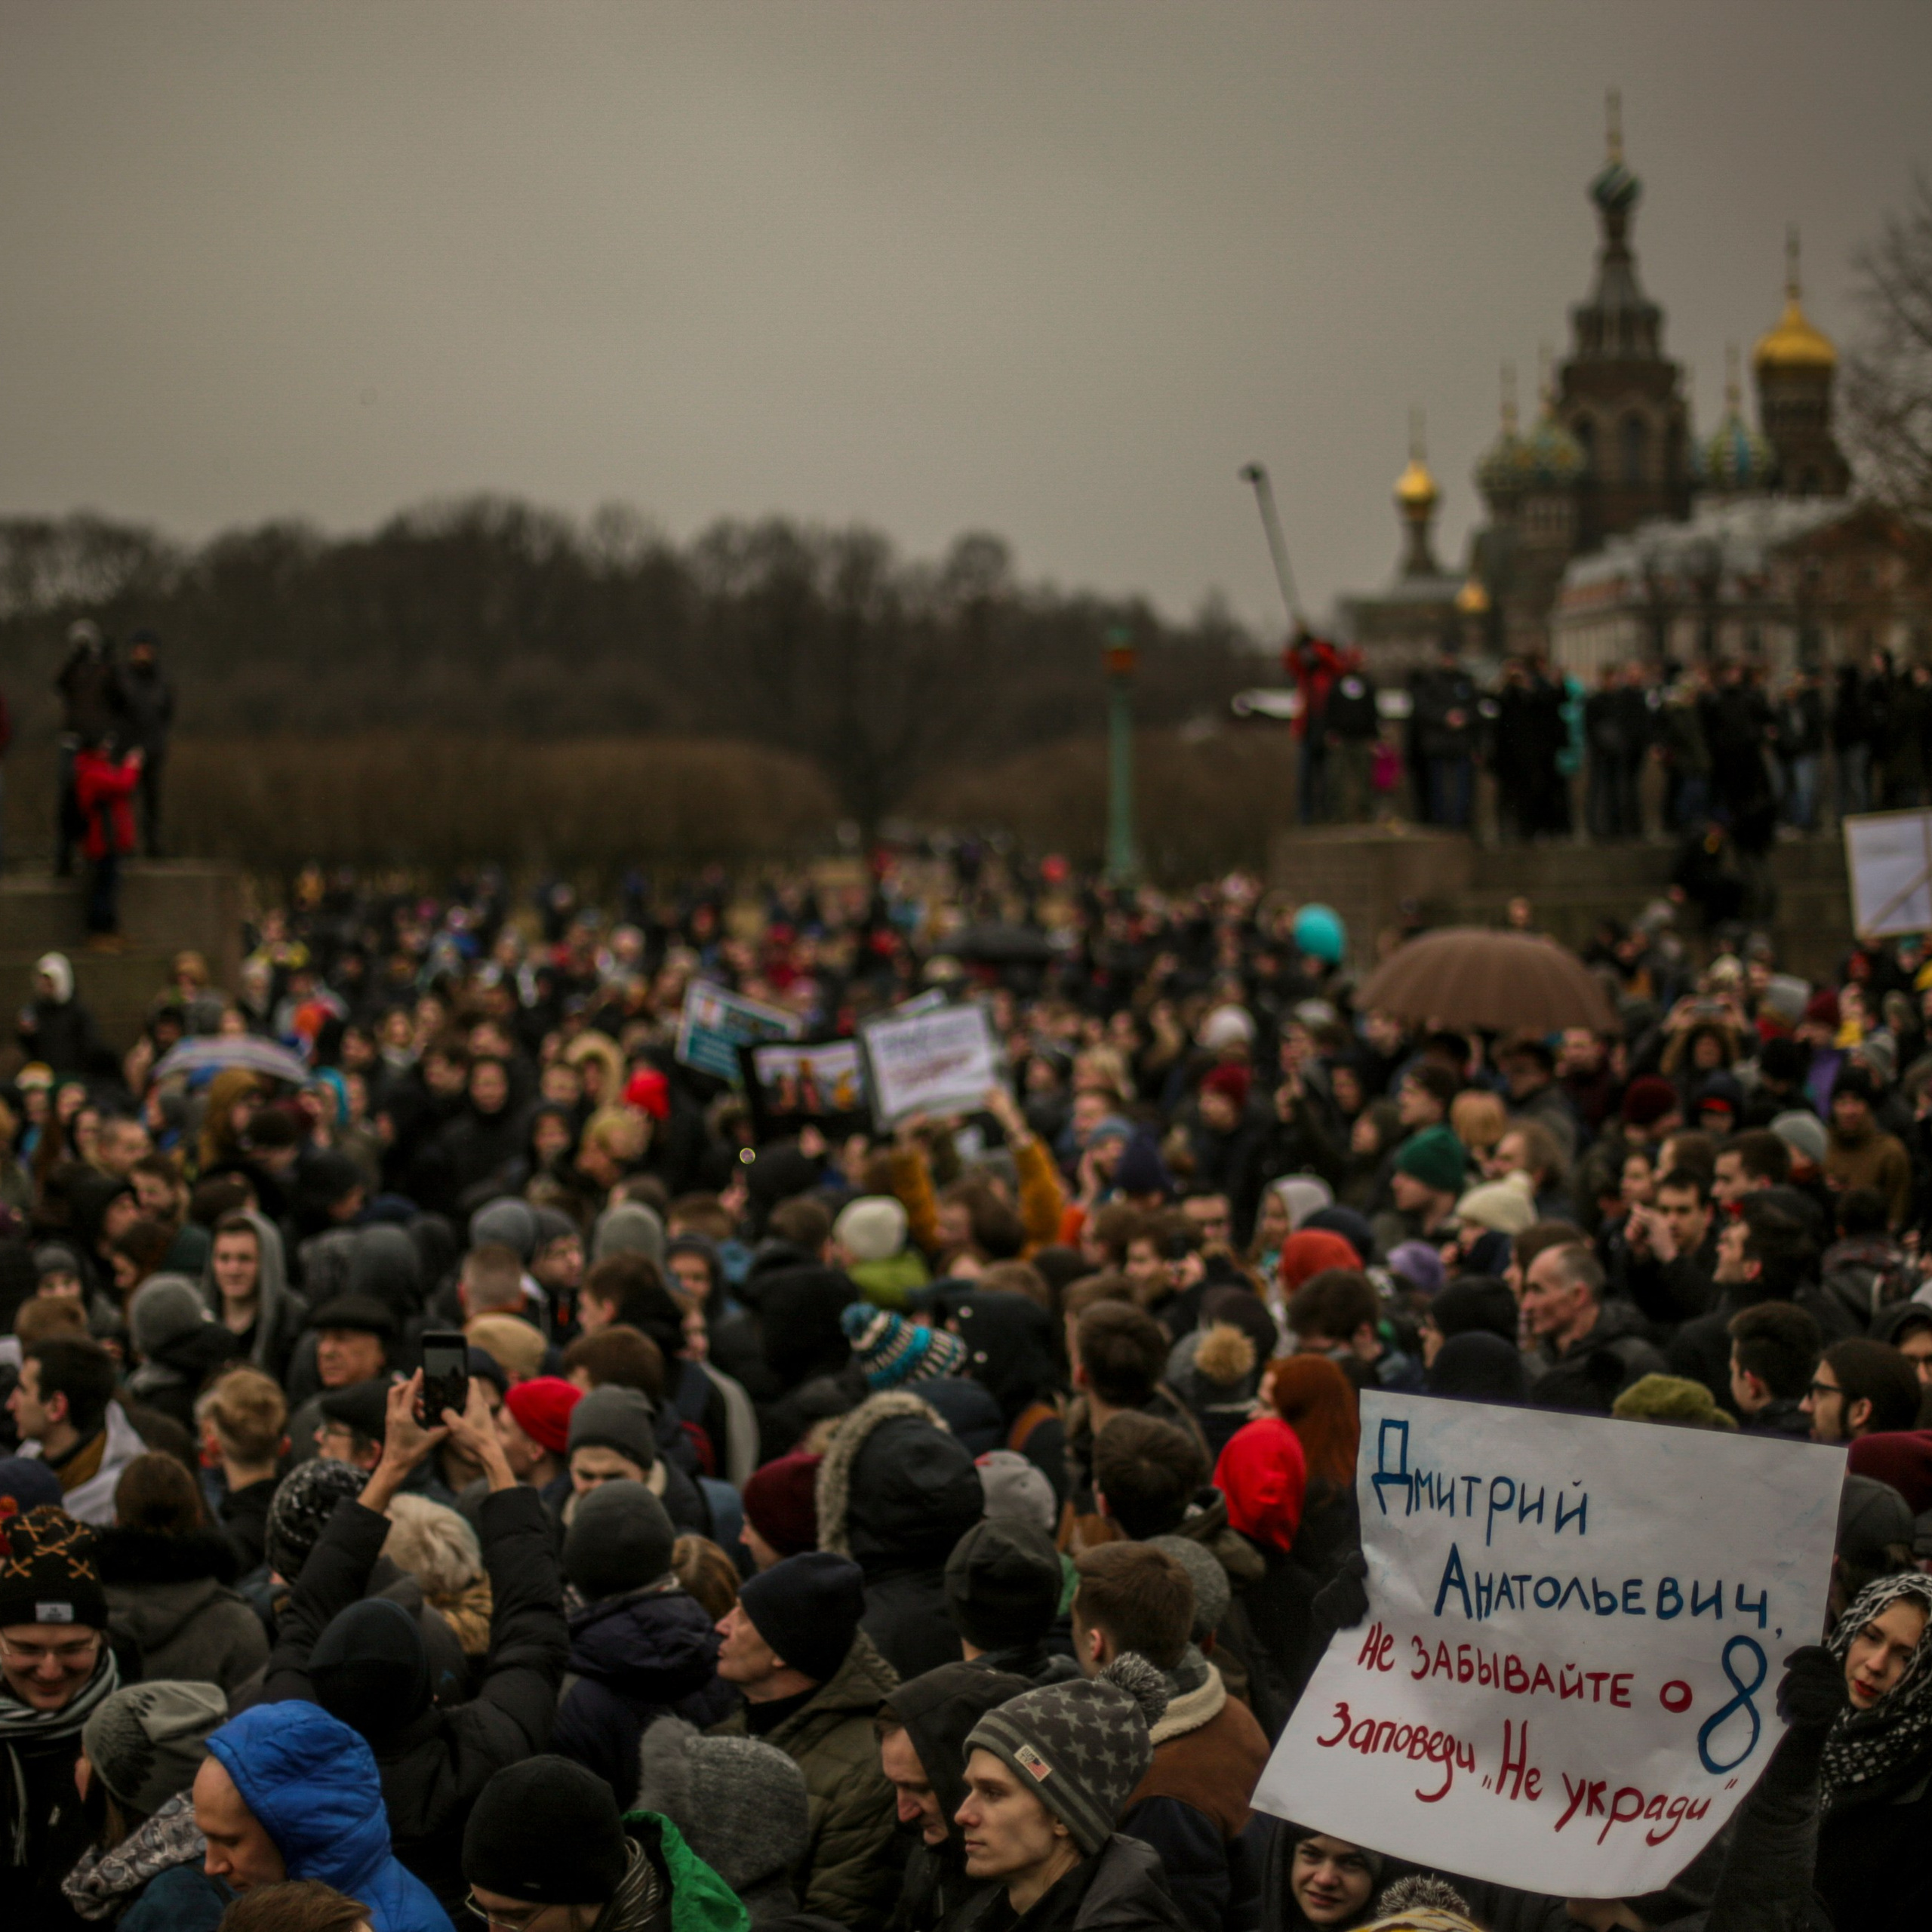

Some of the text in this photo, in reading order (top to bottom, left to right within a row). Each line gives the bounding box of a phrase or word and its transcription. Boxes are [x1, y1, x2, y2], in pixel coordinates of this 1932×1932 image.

[1371, 1418, 1589, 1546] Дмитрий
[1357, 1621, 1395, 1670] Не
[1698, 1634, 1769, 1775] 8
